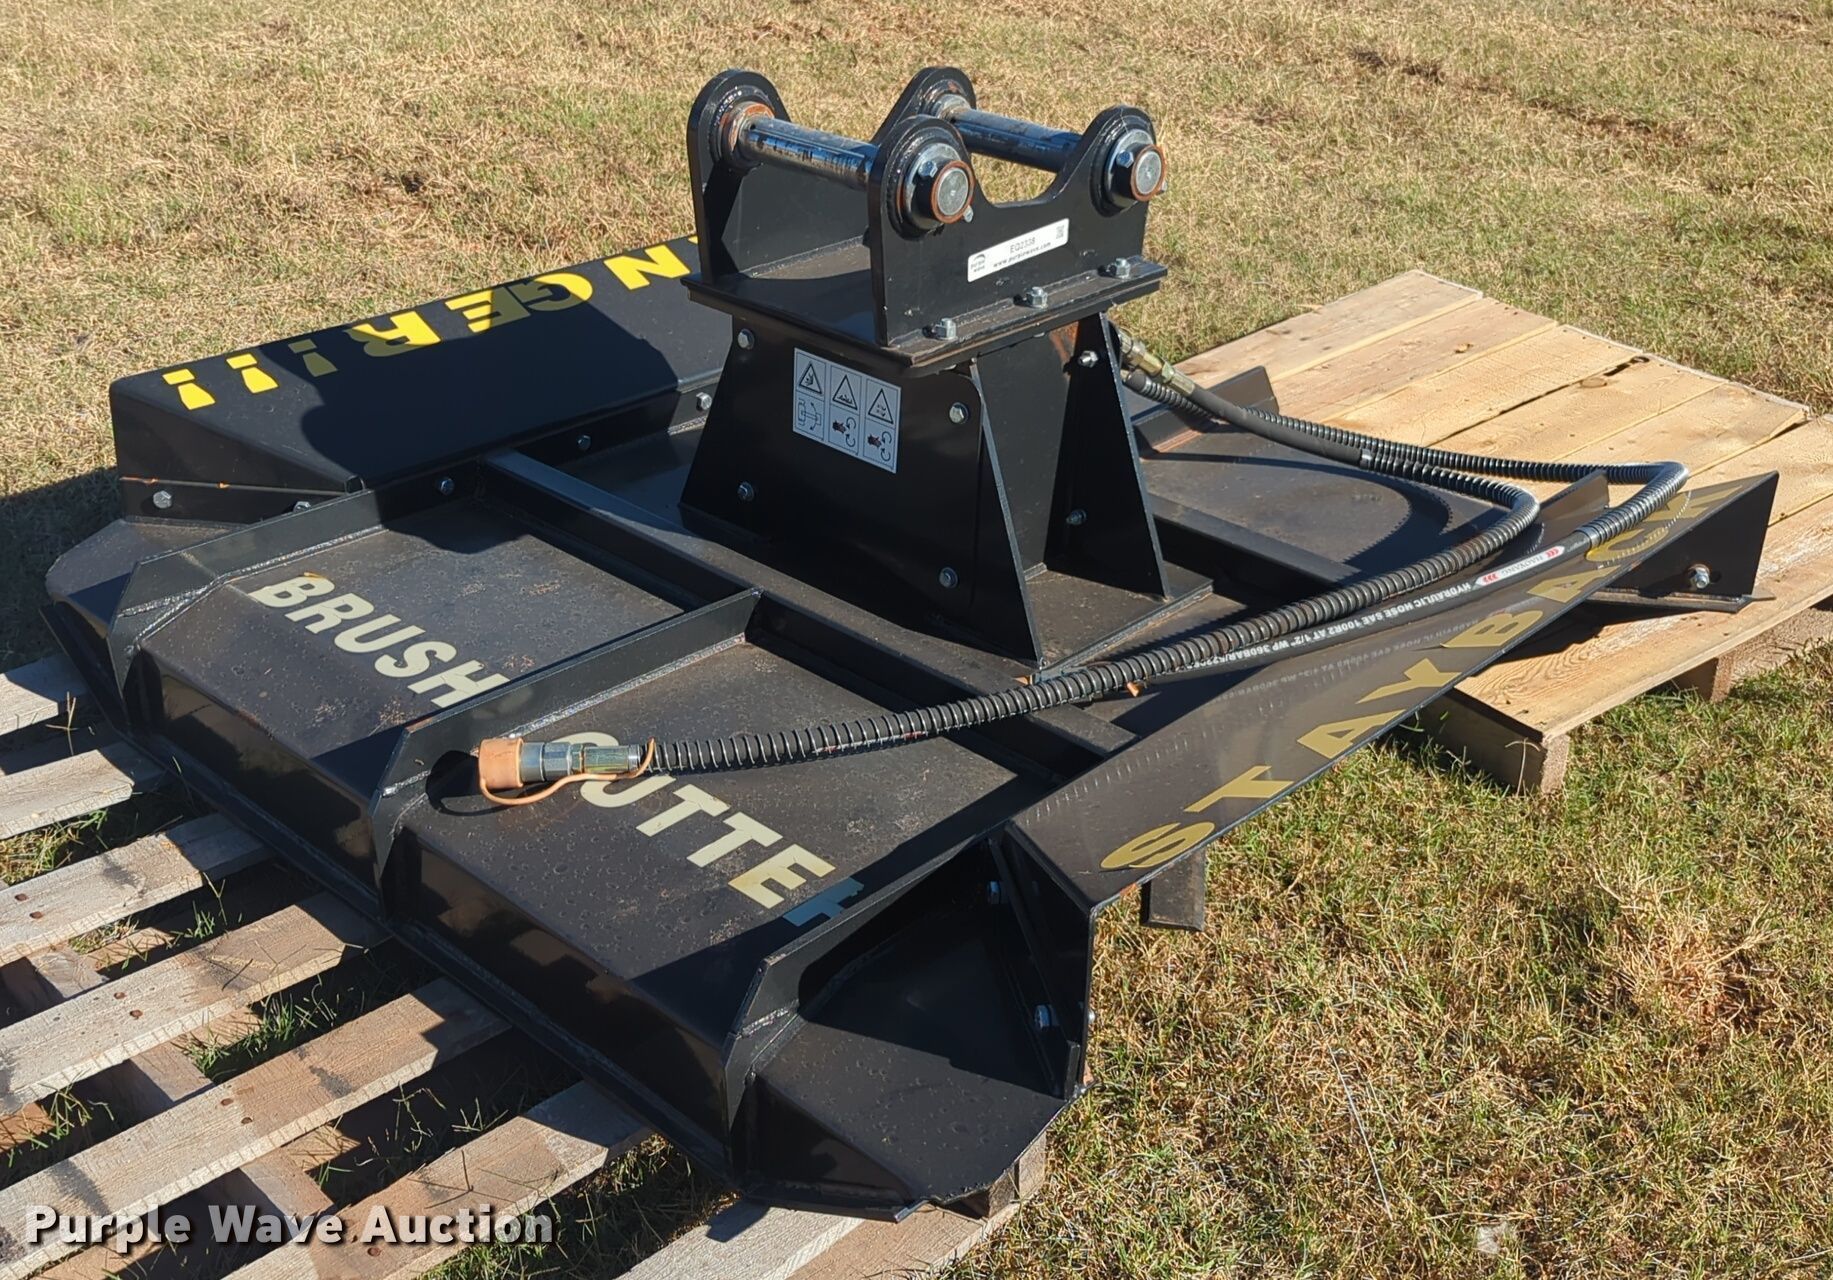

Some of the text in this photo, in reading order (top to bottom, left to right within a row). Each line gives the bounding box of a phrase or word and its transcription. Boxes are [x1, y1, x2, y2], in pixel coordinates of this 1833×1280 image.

[1415, 581, 1472, 608] HYDRAULIC
[1362, 610, 1384, 626] SAE
[1384, 600, 1414, 618] HOSE
[1312, 629, 1327, 641] AT
[1328, 617, 1361, 635] 100R2
[248, 575, 510, 708] BRUSH
[1272, 640, 1289, 652] WP
[1100, 658, 1462, 869] STAY
